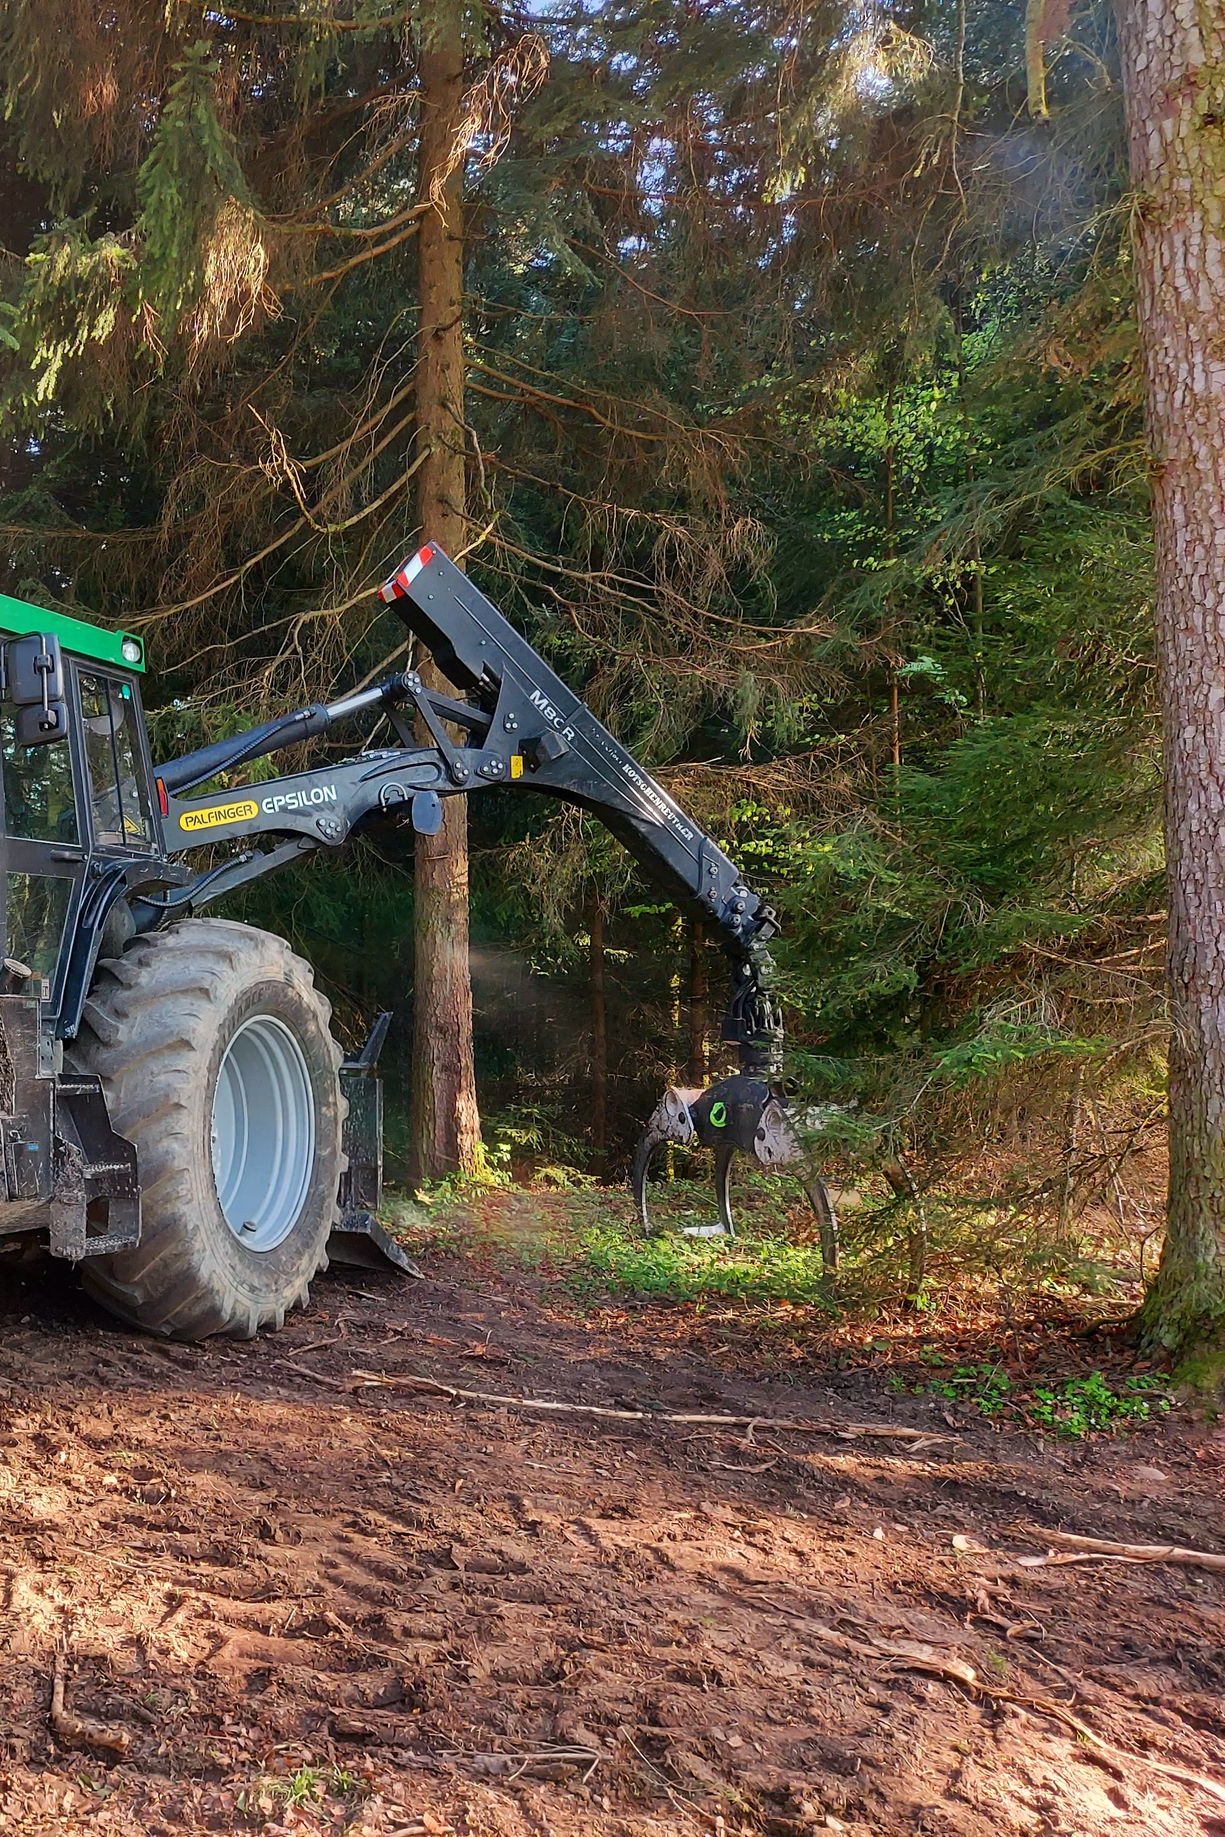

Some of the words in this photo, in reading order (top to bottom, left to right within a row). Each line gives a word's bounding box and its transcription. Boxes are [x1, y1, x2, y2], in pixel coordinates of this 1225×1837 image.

[185, 804, 253, 828] PALFINGER
[262, 784, 338, 814] EPSILON
[622, 763, 695, 841] KOTSCHENREUTHER
